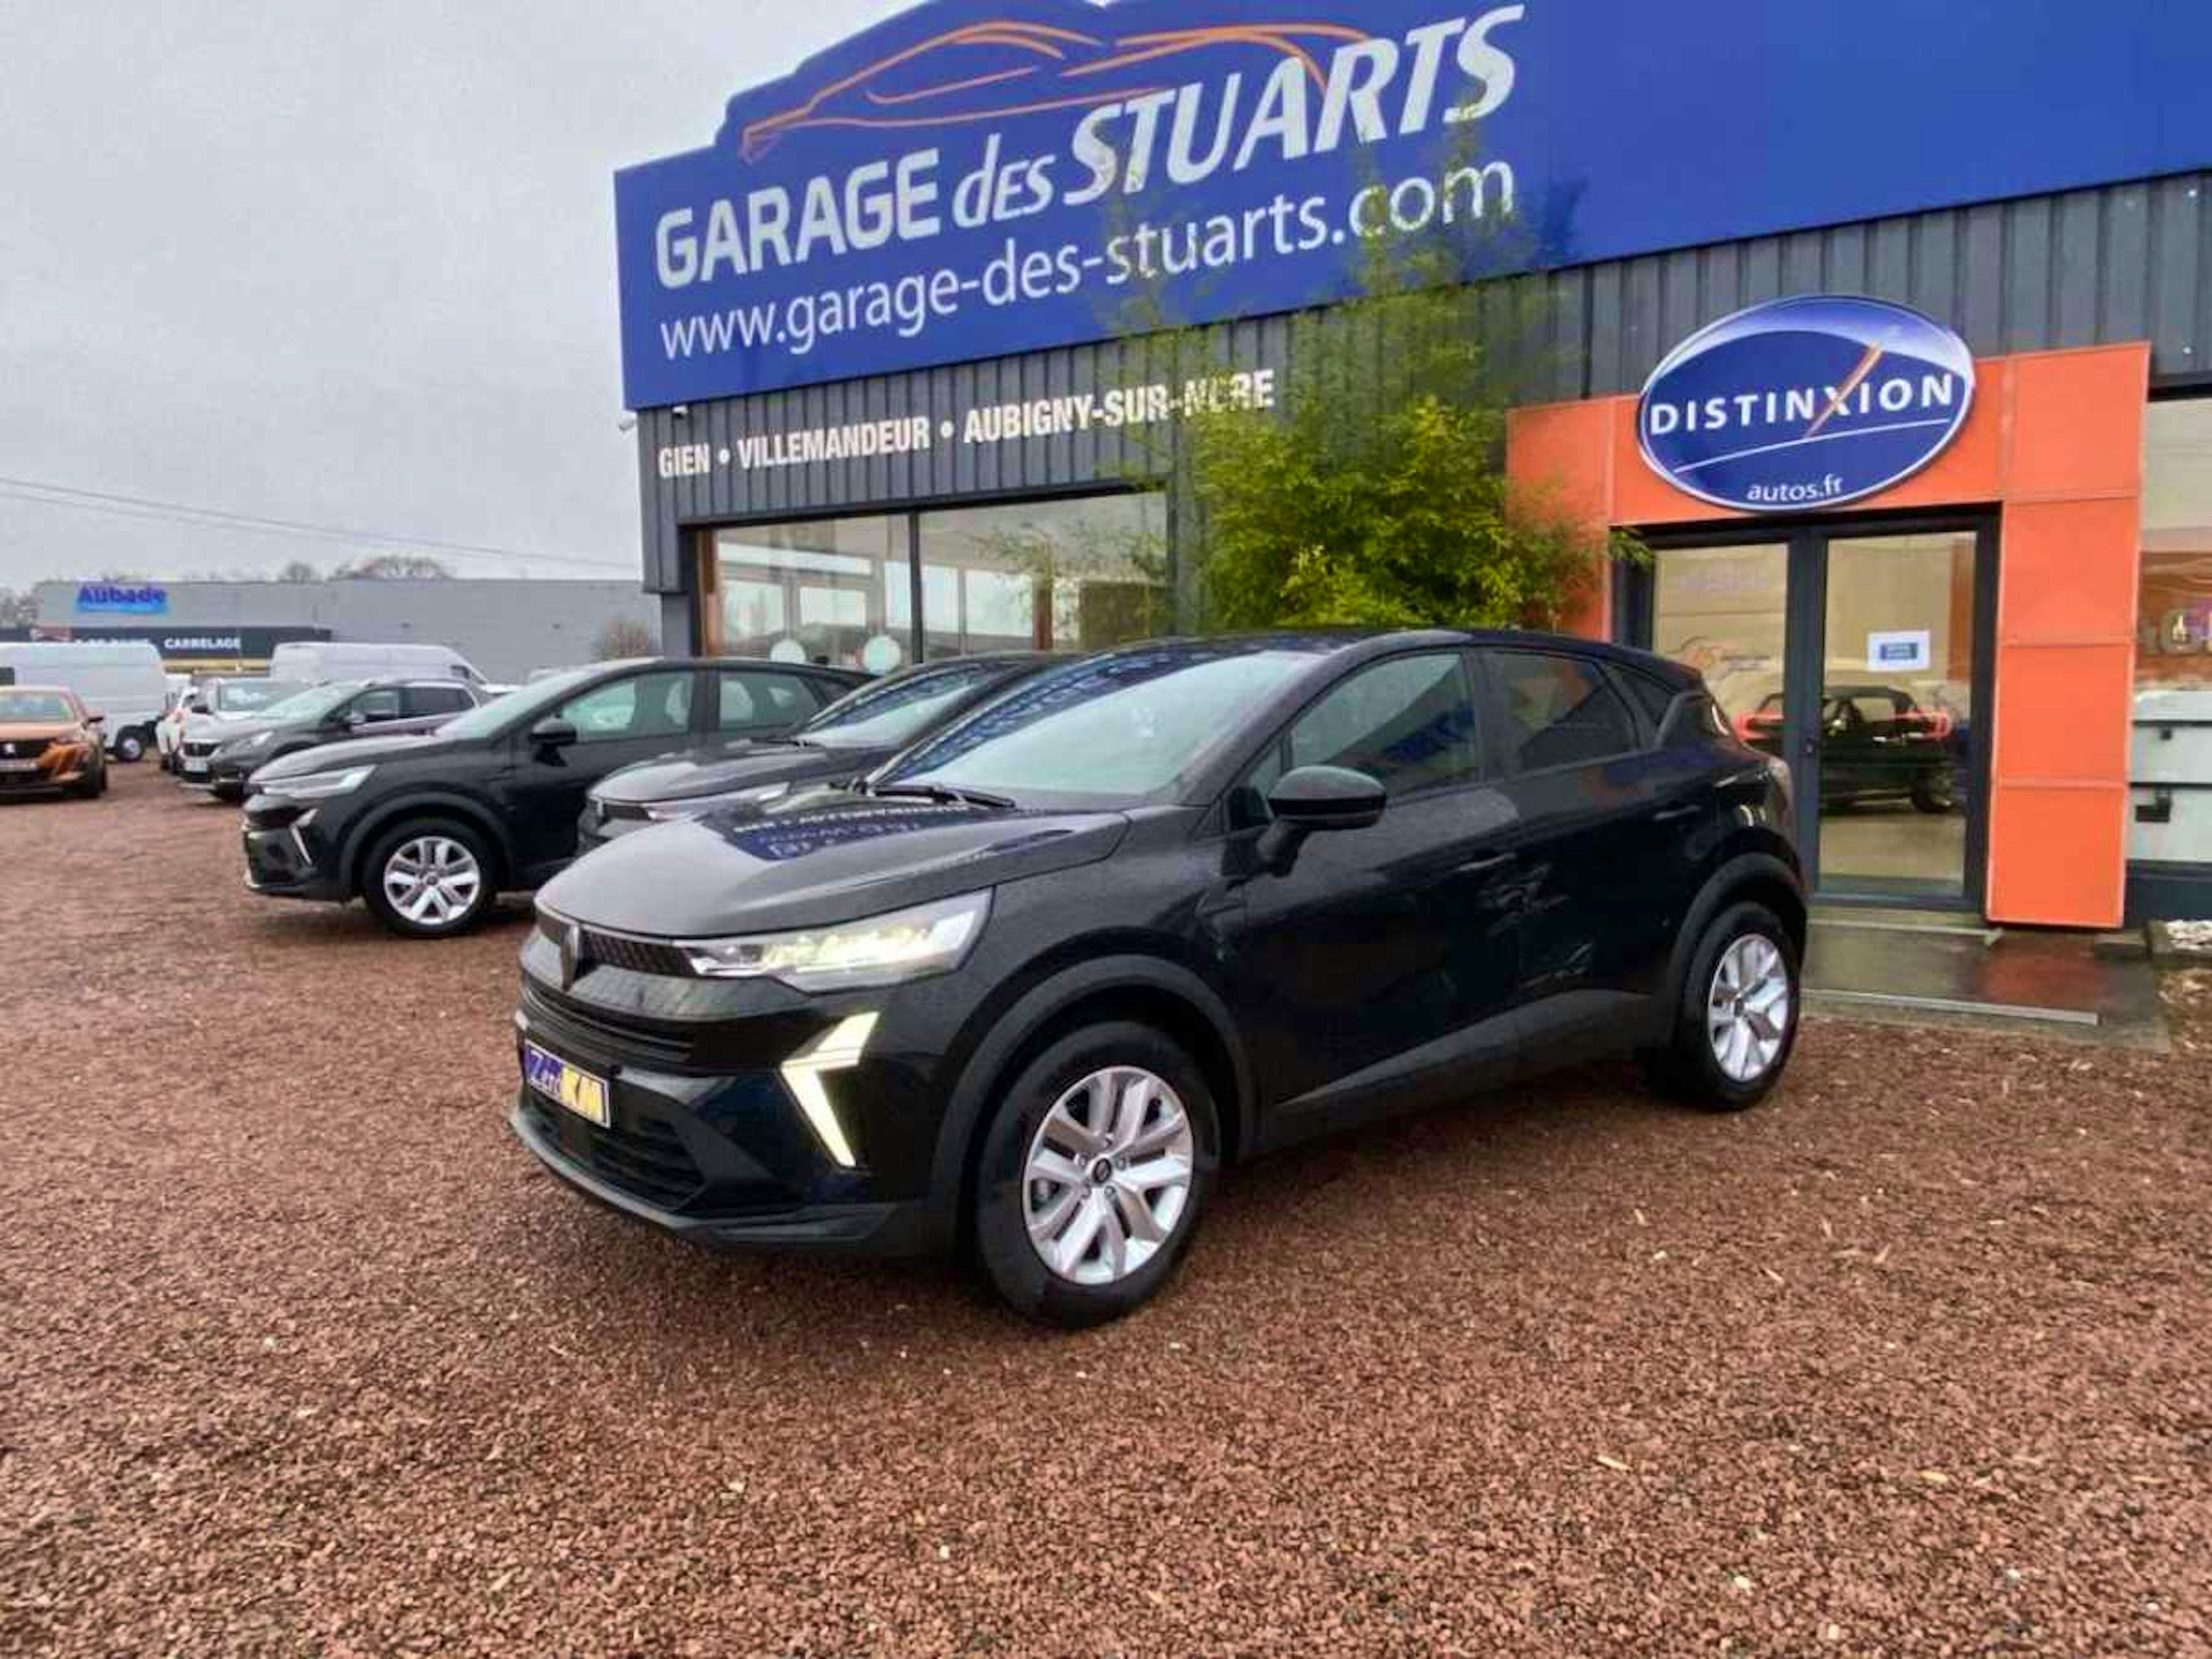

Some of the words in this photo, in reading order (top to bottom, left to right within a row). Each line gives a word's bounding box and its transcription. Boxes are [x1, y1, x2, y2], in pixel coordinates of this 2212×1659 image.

[656, 147, 941, 289] GARAGE
[1063, 4, 1525, 206] STUARTS
[660, 160, 1514, 359] www.garage-des-stuarts.com
[1650, 372, 1952, 435] DISTINXION
[658, 443, 710, 478] GIEN
[738, 416, 930, 469] VILLEMANDEUR
[1747, 473, 1843, 501] autos.fr
[77, 584, 167, 603] Aubade
